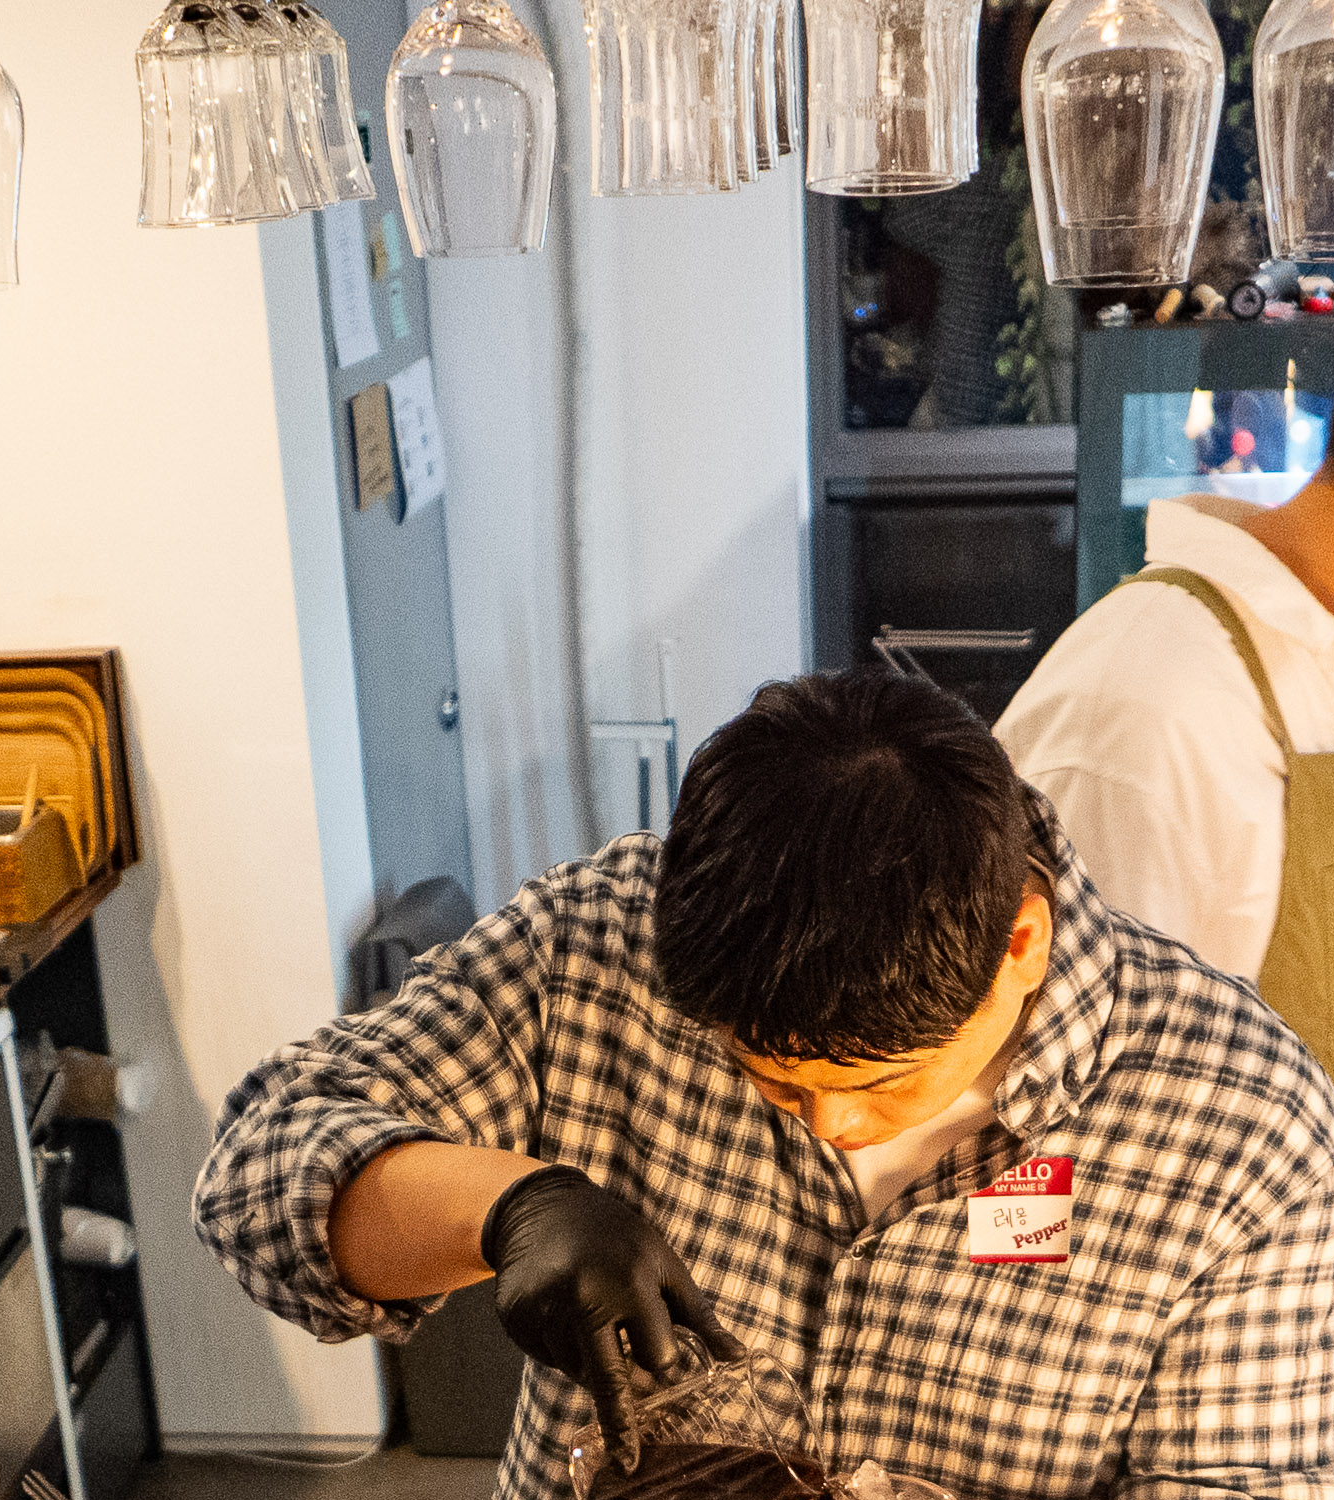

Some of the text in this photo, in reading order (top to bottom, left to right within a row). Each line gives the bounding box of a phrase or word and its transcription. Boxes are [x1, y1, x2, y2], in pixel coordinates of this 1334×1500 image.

[995, 1184, 1047, 1192] MY NAME IS
[1012, 1217, 1068, 1249] Pepper
